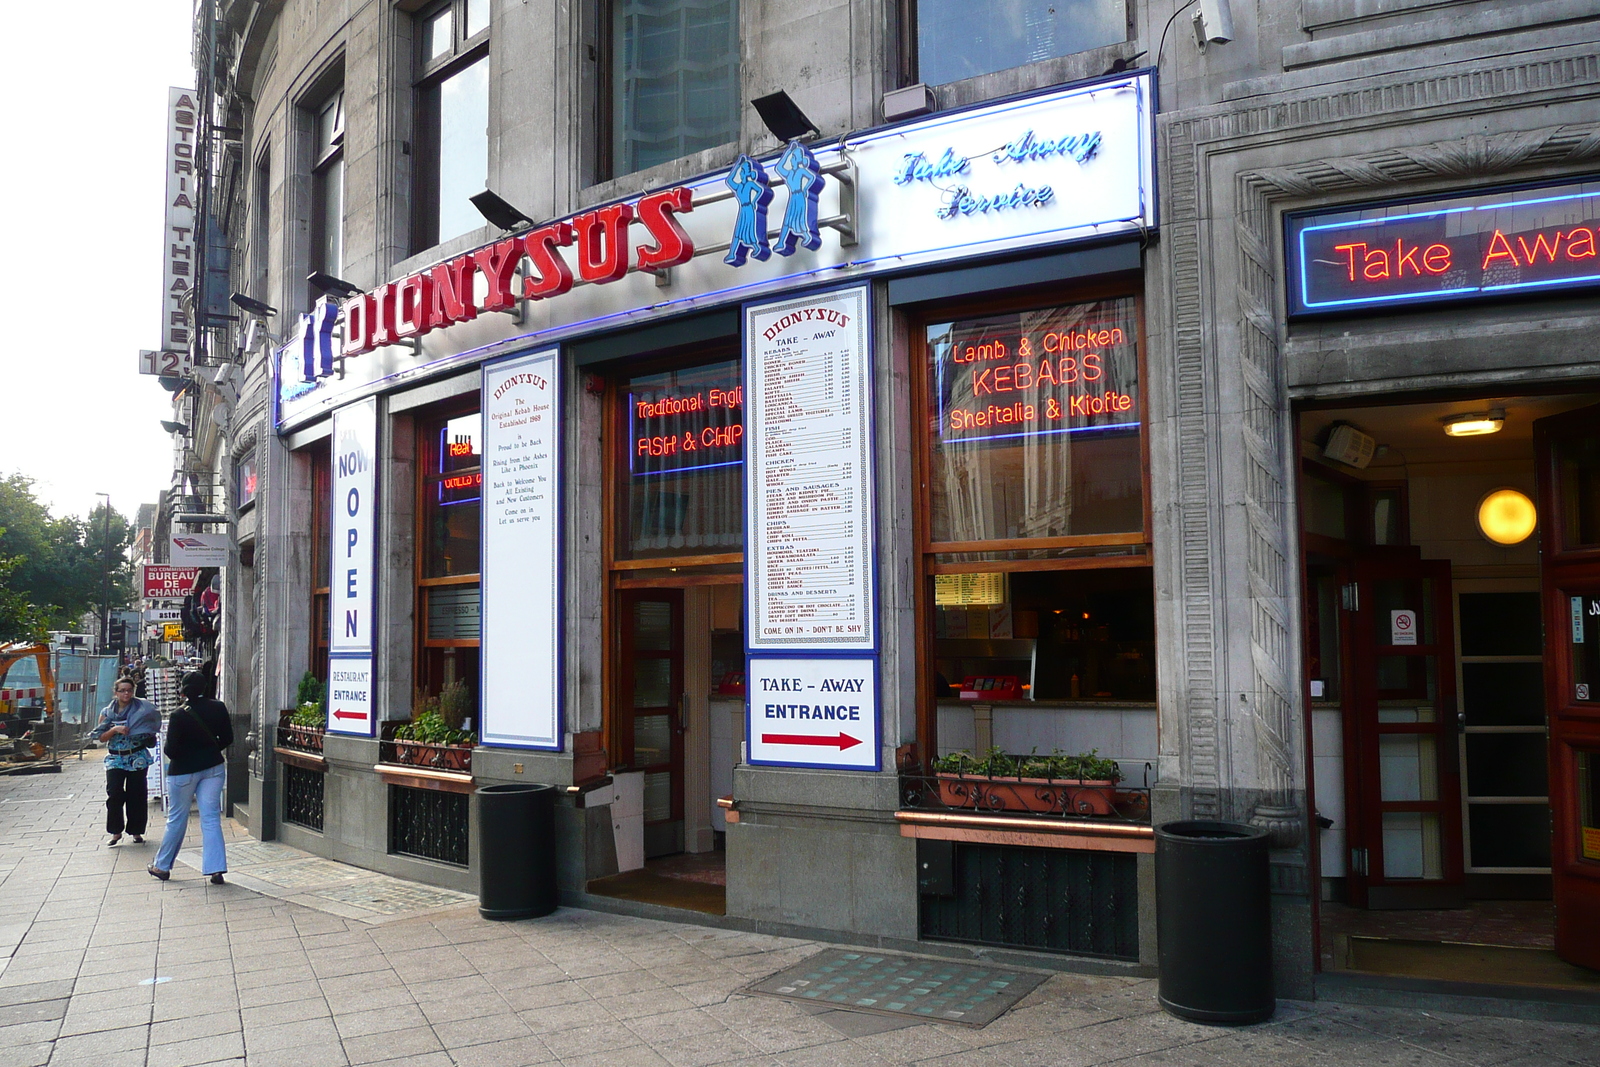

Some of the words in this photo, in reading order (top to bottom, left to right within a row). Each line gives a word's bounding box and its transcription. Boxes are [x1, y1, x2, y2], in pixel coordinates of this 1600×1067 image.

[173, 94, 194, 209] ASTORIA
[893, 146, 969, 186] Take
[994, 127, 1101, 163] Away
[936, 183, 1054, 219] Service
[1335, 239, 1450, 281] Take
[1483, 228, 1600, 269] Awa
[341, 187, 693, 357] DIONYSUS
[170, 226, 189, 343] THEATRE
[763, 308, 850, 341] DIONYSUS
[776, 336, 798, 346] TAKE
[812, 330, 836, 341] AWAY
[954, 340, 1004, 363] Lamb
[1019, 338, 1031, 356] &
[1044, 328, 1122, 352] Chicken
[764, 347, 790, 355] KEBABS
[973, 354, 1101, 396] KEBABS
[494, 373, 547, 400] DIONYSUS
[637, 394, 701, 418] Traditional
[710, 387, 743, 408] Engli
[1046, 398, 1059, 419] &
[1070, 391, 1131, 416] Kiofte
[491, 410, 512, 420] Original
[514, 407, 530, 415] Kebab
[533, 404, 549, 412] House
[499, 417, 527, 429] Established
[498, 443, 512, 451] Proud
[530, 438, 542, 446] Back
[638, 436, 676, 456] FISH
[684, 432, 695, 451] &
[702, 424, 743, 447] CHIP
[339, 450, 369, 479] NOW
[519, 463, 538, 471] Phoenix
[765, 458, 795, 466] CHICKEN
[494, 481, 505, 489] Back
[803, 482, 840, 490] SAUSAGES
[519, 494, 544, 502] Customers
[505, 508, 518, 516] Come
[346, 487, 359, 638] OPEN
[148, 572, 194, 580] BUREAU
[164, 580, 179, 588] DE
[148, 588, 195, 597] CHANGE
[847, 625, 861, 633] SHY
[333, 671, 369, 682] RESTAURANT
[760, 678, 803, 692] TAKE
[820, 679, 864, 692] AWAY
[334, 690, 366, 702] ENTRANCE
[765, 704, 860, 720] ENTRANCE
